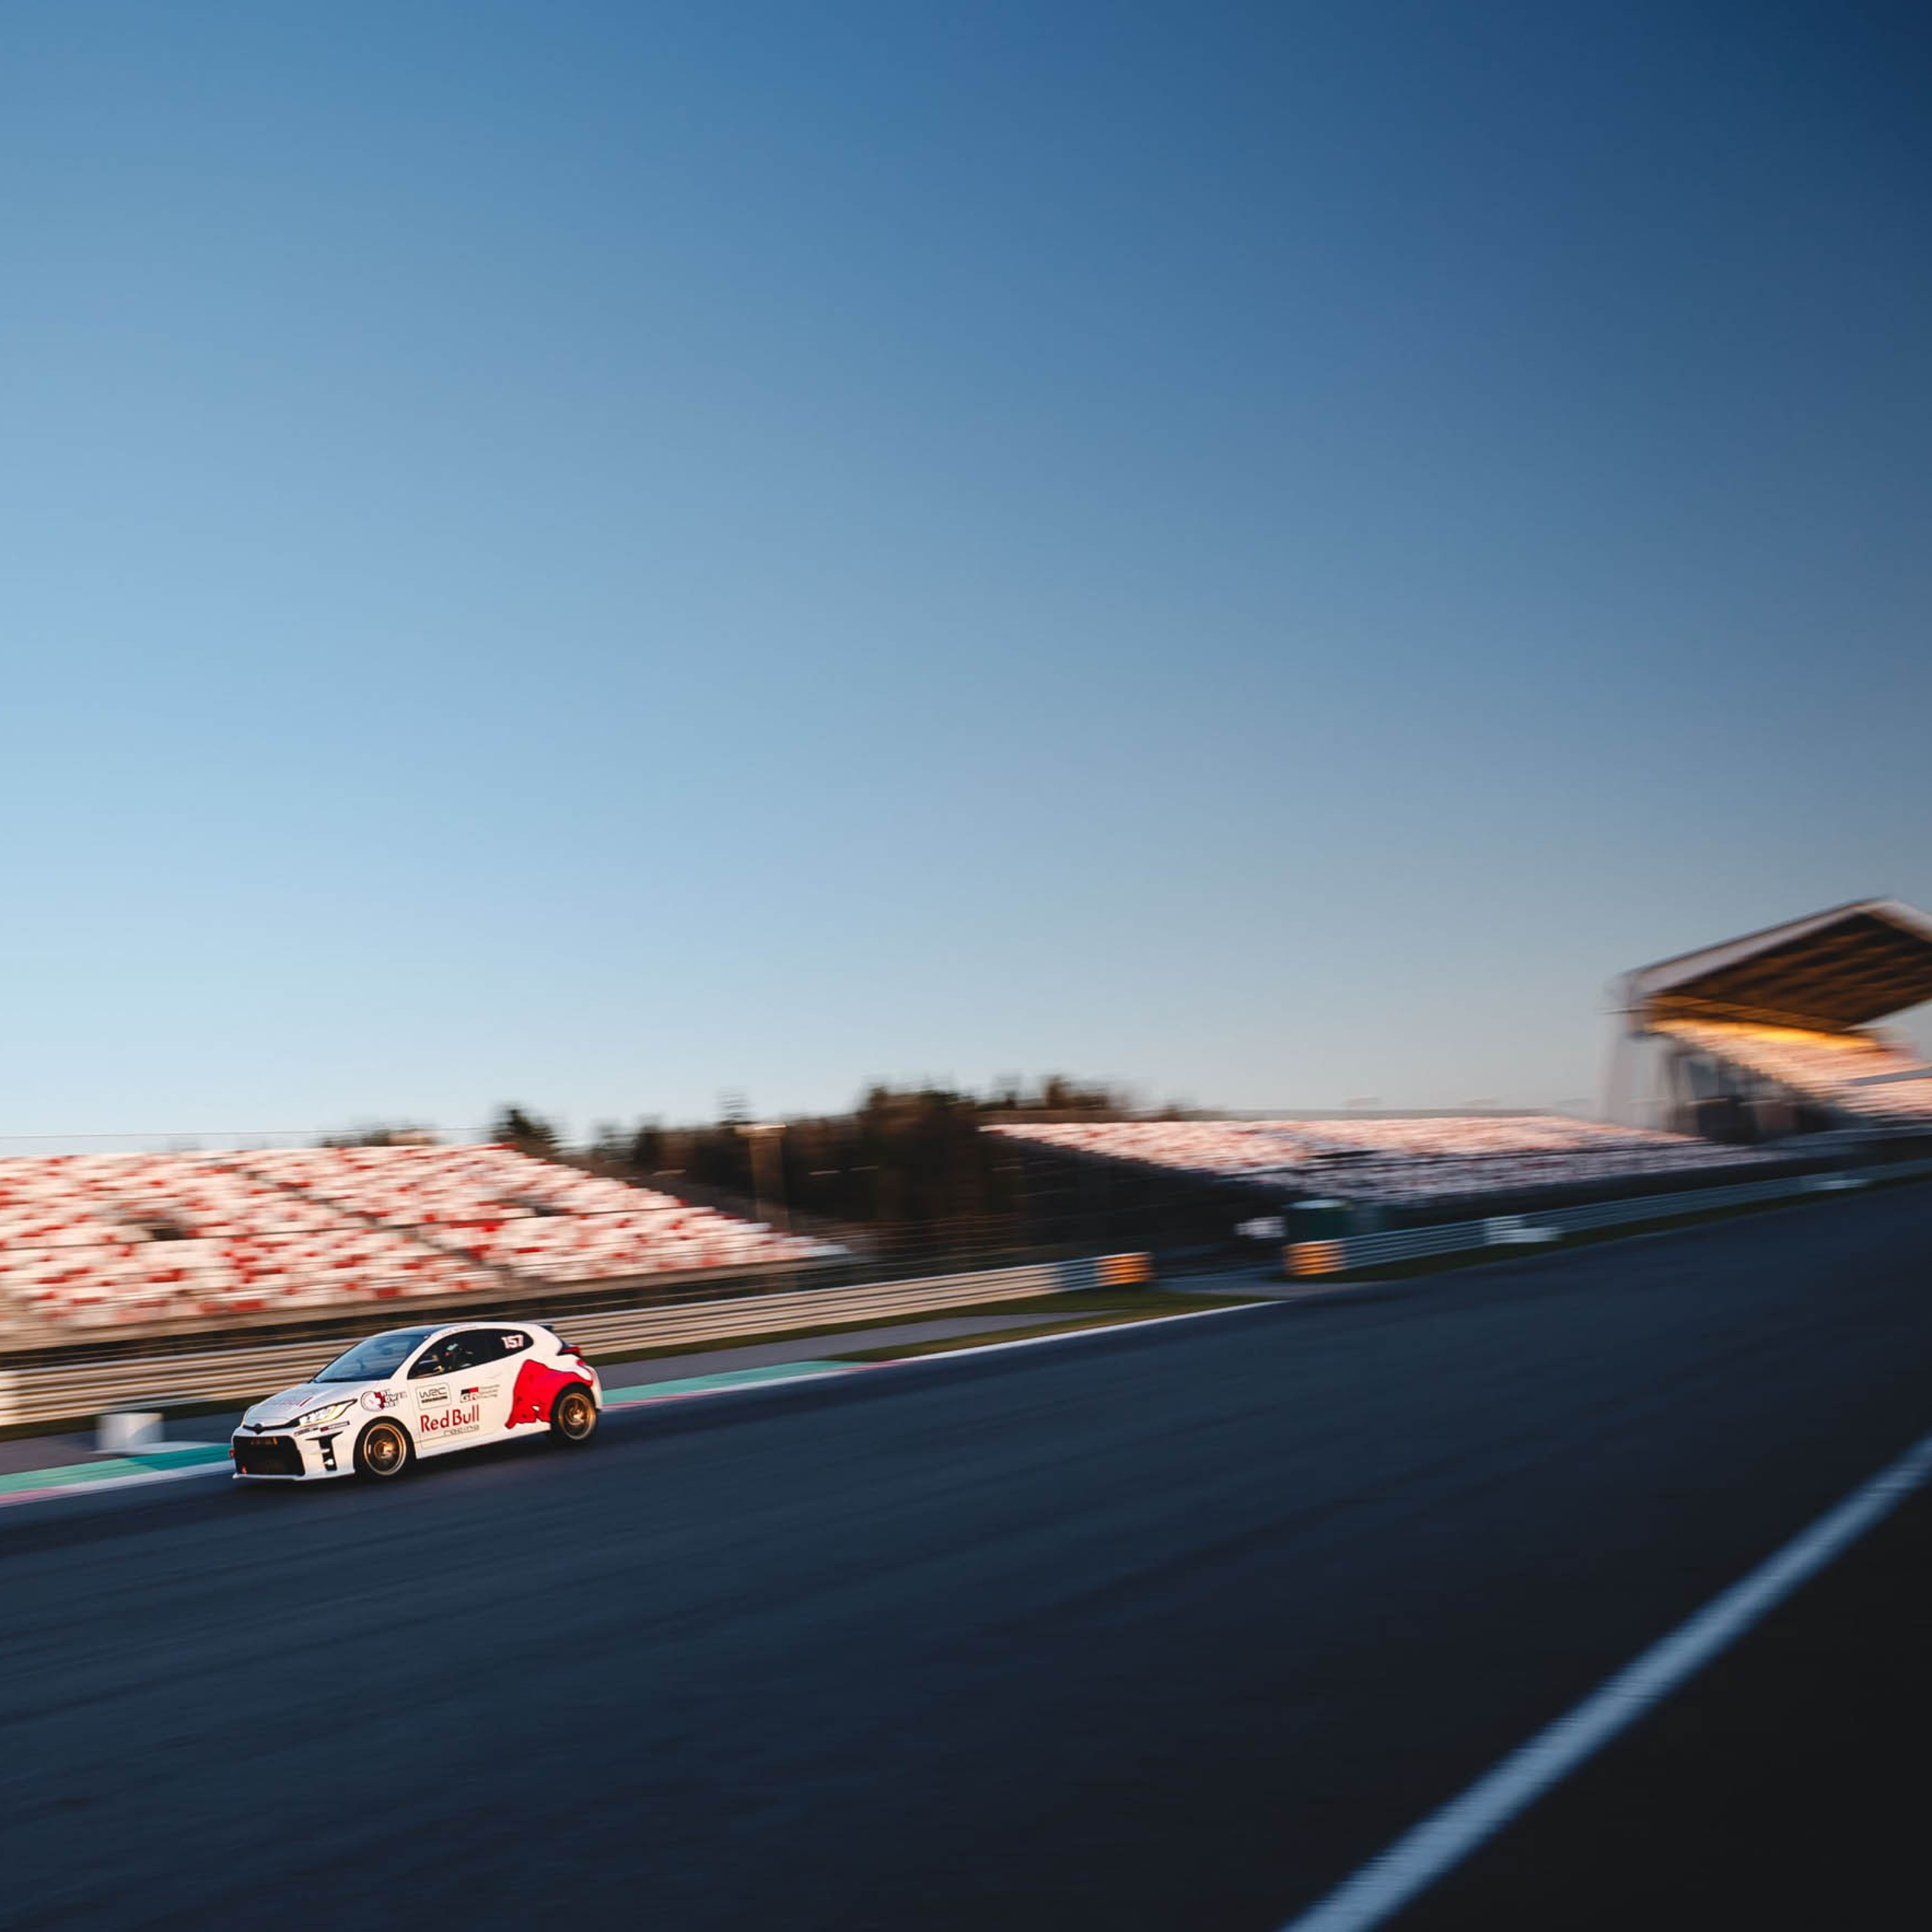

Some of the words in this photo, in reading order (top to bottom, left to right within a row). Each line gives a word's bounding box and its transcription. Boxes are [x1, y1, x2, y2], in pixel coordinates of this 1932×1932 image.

[501, 1334, 524, 1349] 157
[419, 1387, 447, 1398] WRC
[420, 1410, 450, 1433] Red
[452, 1404, 479, 1426] Bull
